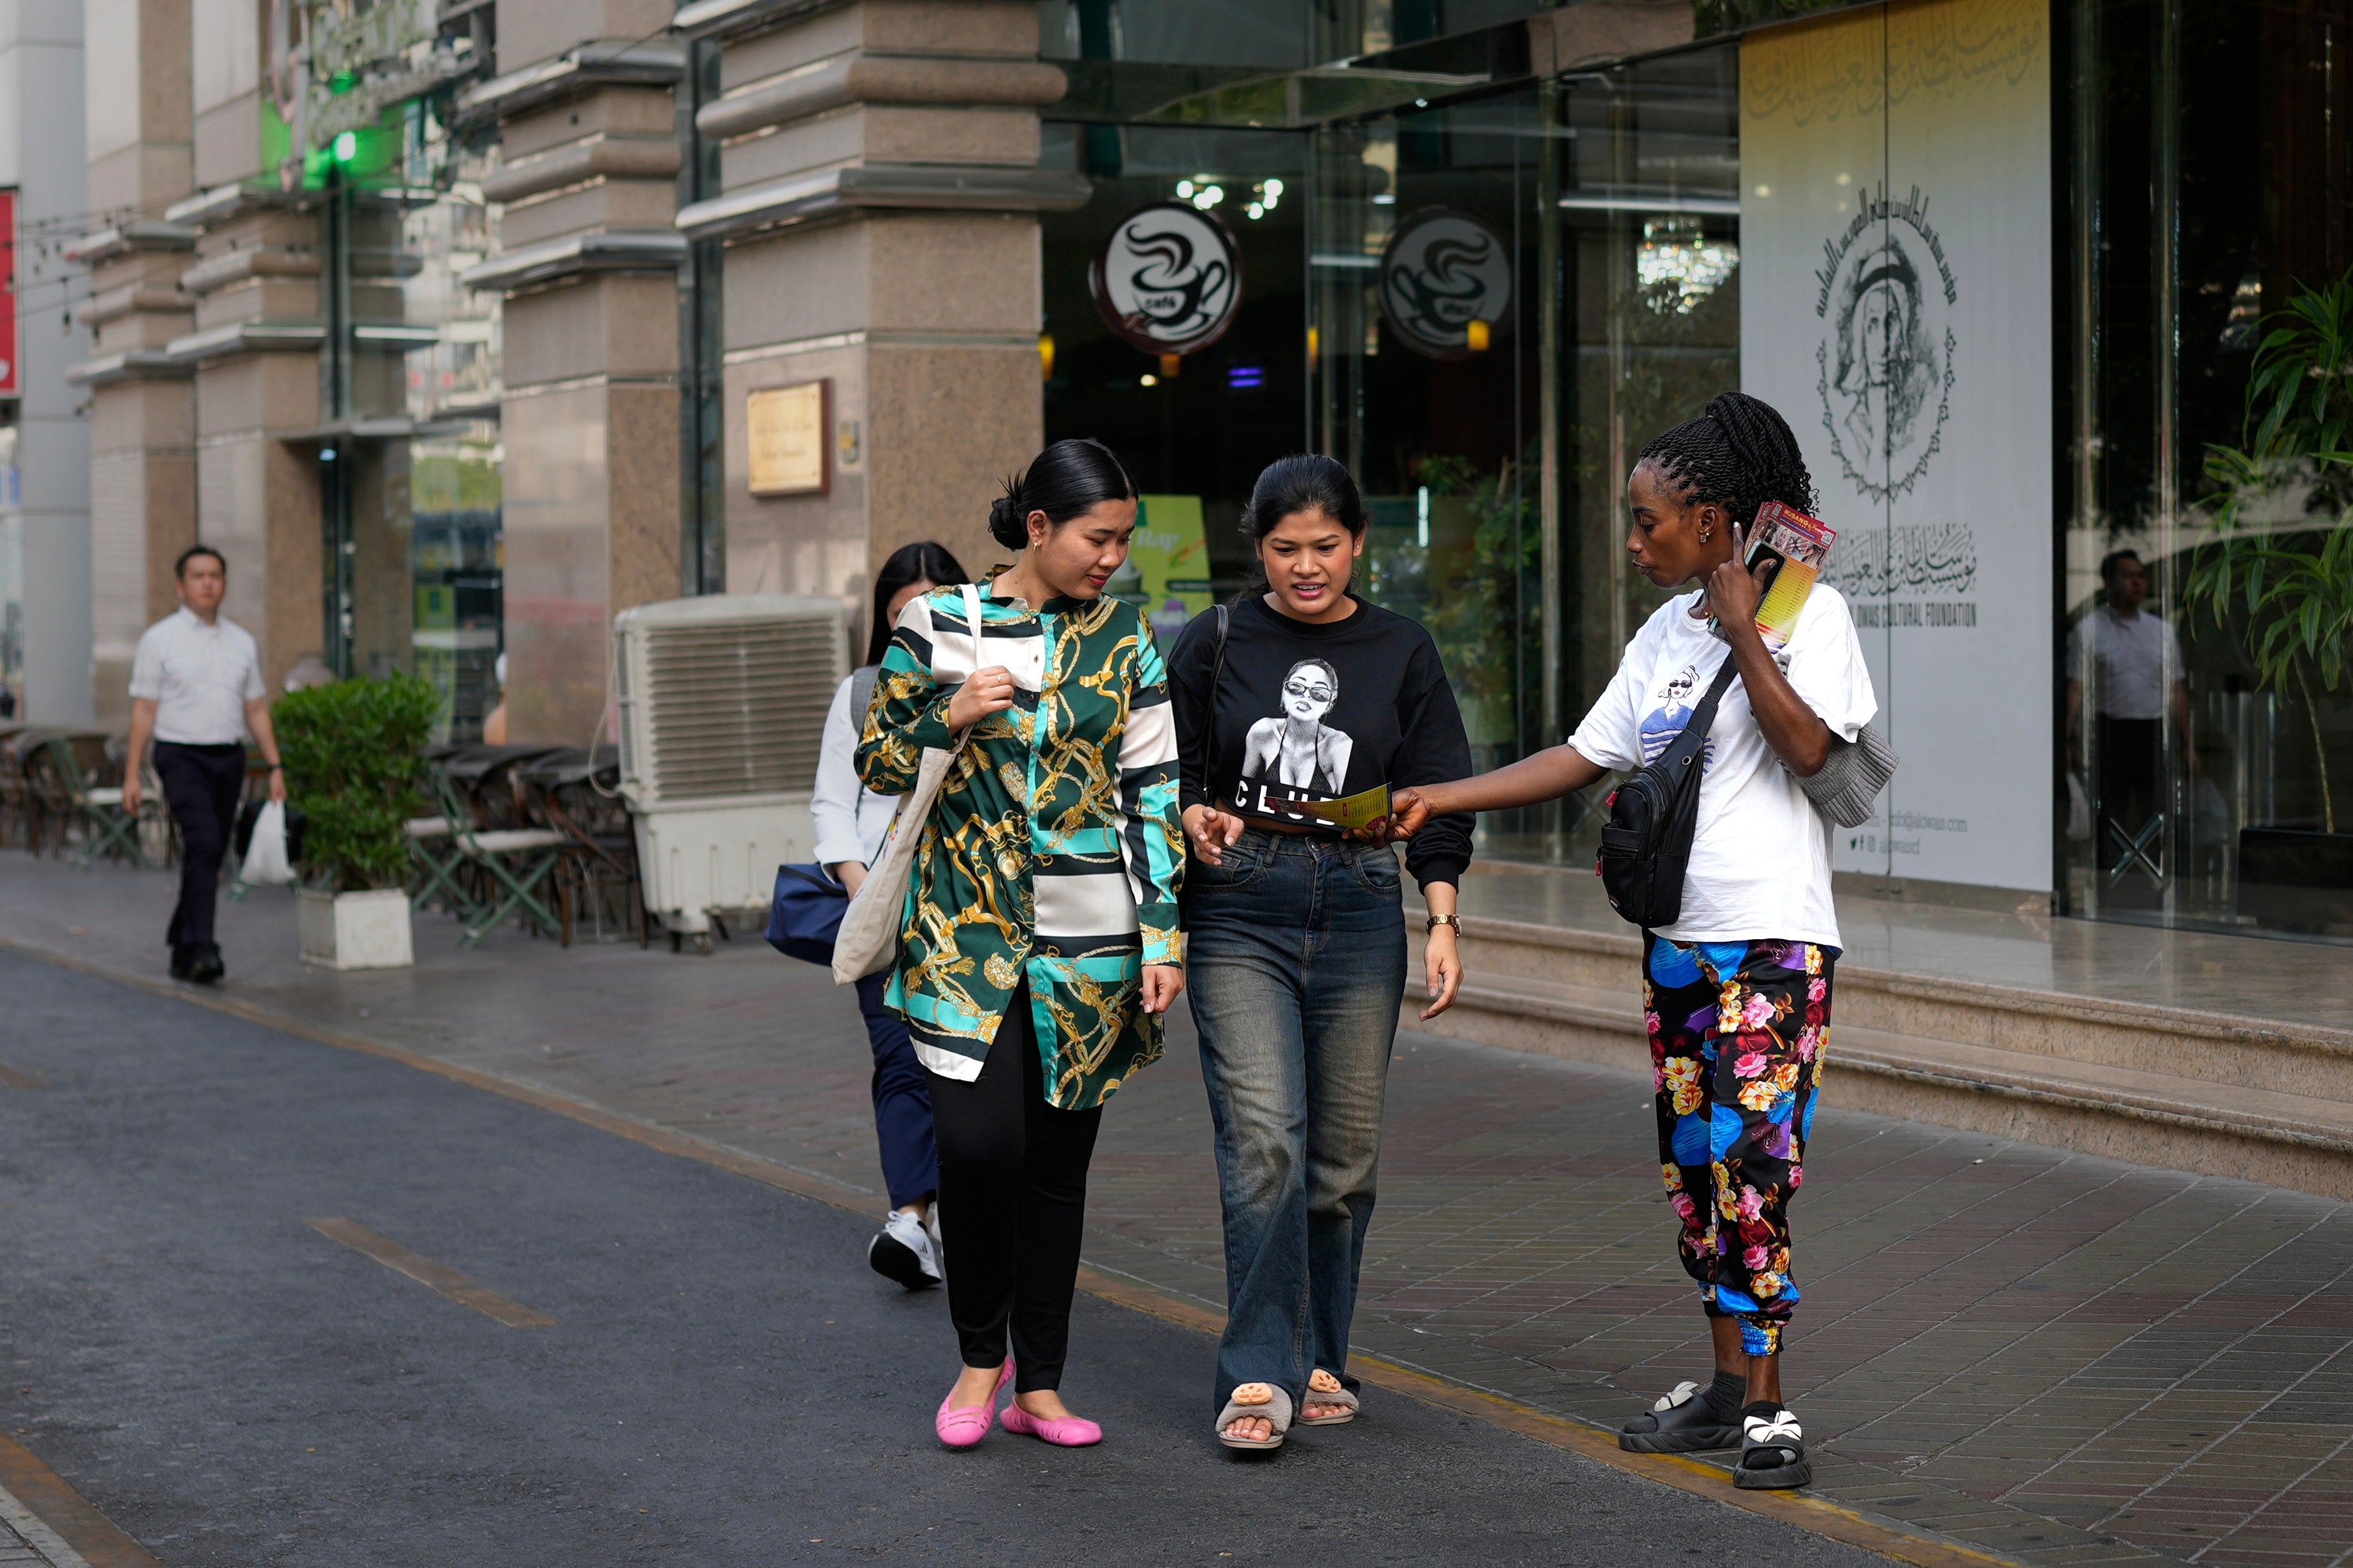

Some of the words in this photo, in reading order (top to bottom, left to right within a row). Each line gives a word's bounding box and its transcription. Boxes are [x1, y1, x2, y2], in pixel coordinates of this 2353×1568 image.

[1783, 509, 1809, 526] MUSANG
[1926, 602, 1977, 627] FOUNDATION
[1889, 809, 1968, 833] nfo@alowais.com
